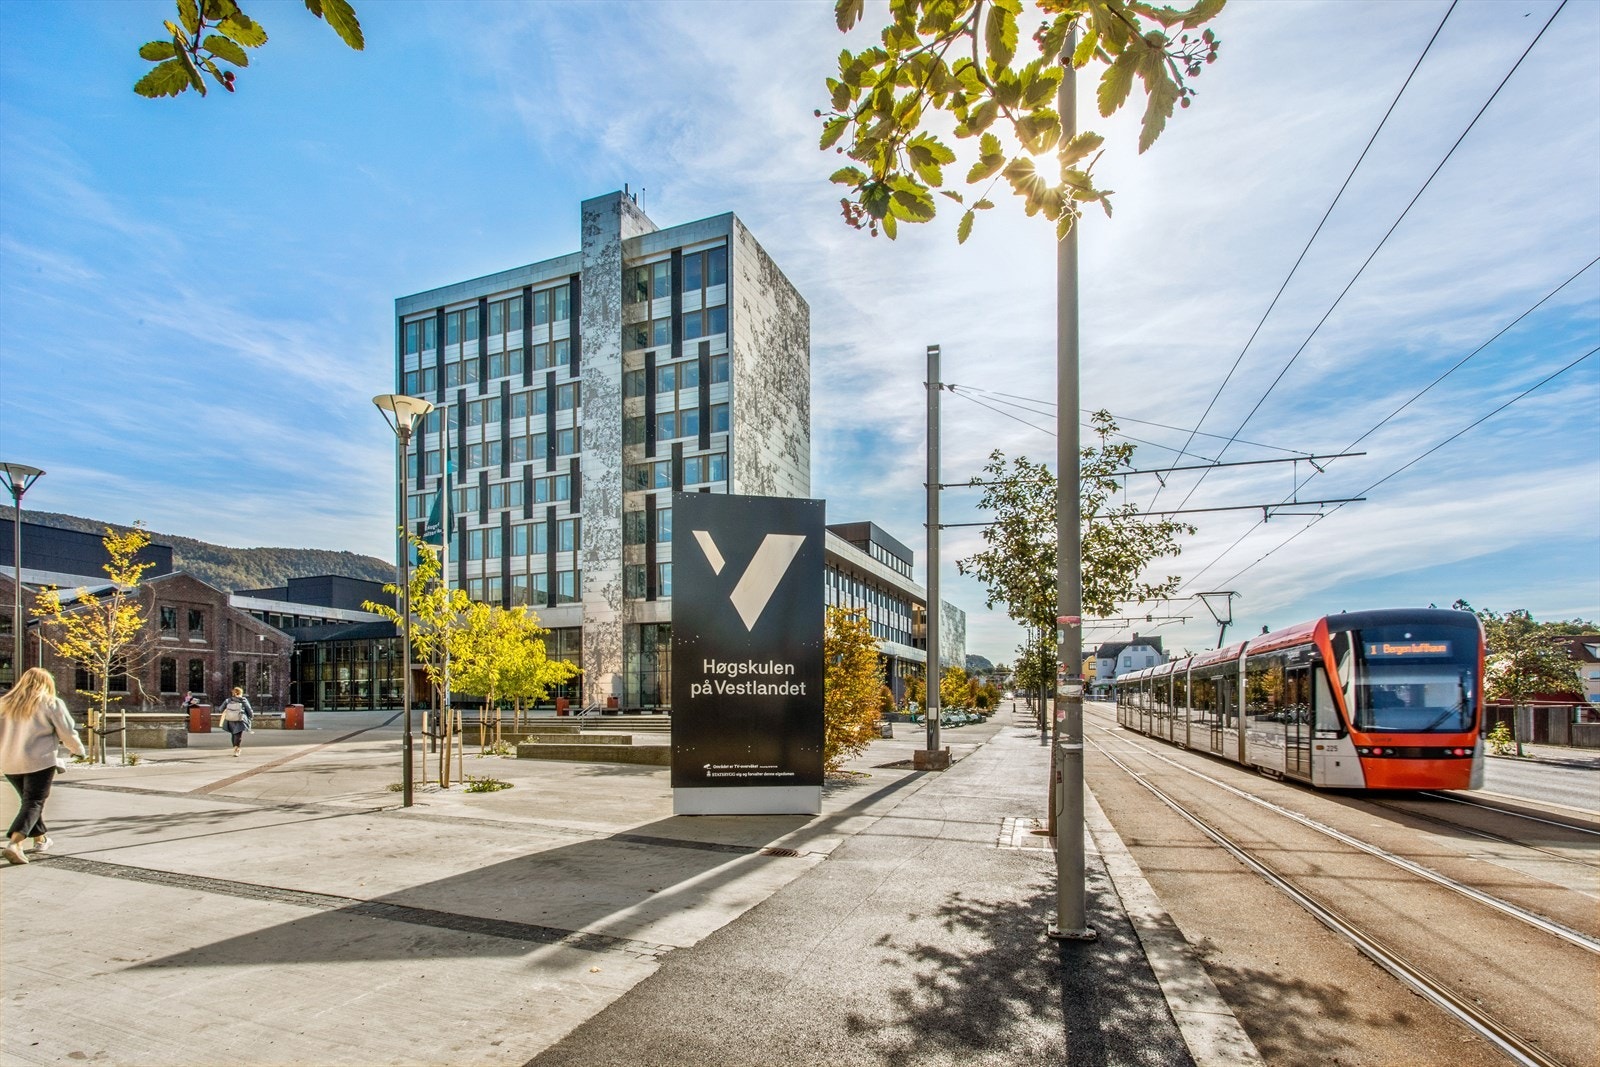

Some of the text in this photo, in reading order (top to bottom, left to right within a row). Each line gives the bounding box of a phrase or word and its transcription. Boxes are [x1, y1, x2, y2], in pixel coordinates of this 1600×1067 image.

[1370, 644, 1377, 655] 1
[1382, 643, 1411, 656] Bergen
[703, 658, 795, 678] Høgskulen
[691, 679, 807, 699] på Vestlandet
